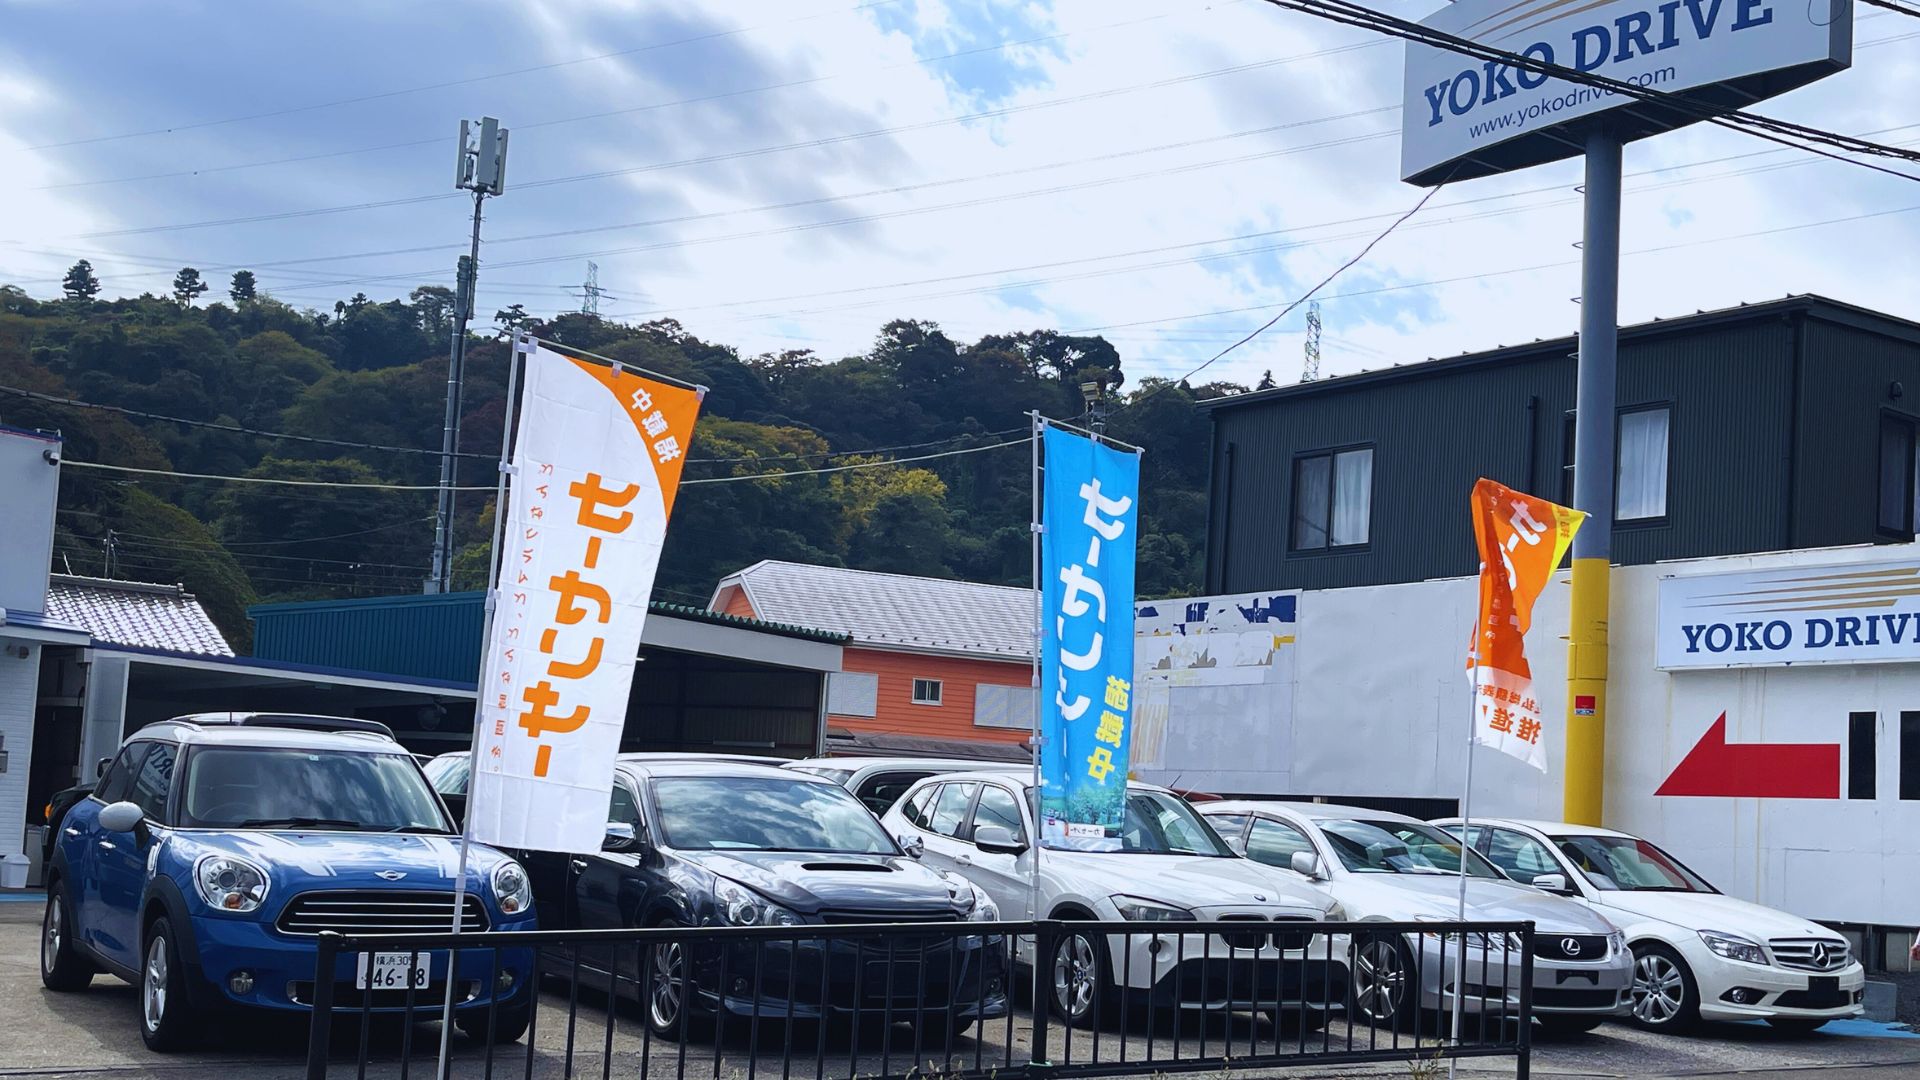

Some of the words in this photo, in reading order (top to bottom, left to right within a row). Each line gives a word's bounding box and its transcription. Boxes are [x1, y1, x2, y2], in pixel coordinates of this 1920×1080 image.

[1425, 42, 1554, 127] YOKO
[1572, 0, 1773, 73] DRIVE
[1470, 67, 1675, 138] www.yokodrivcom
[1681, 620, 1792, 653] YOKO
[1804, 612, 1920, 649] DRIV
